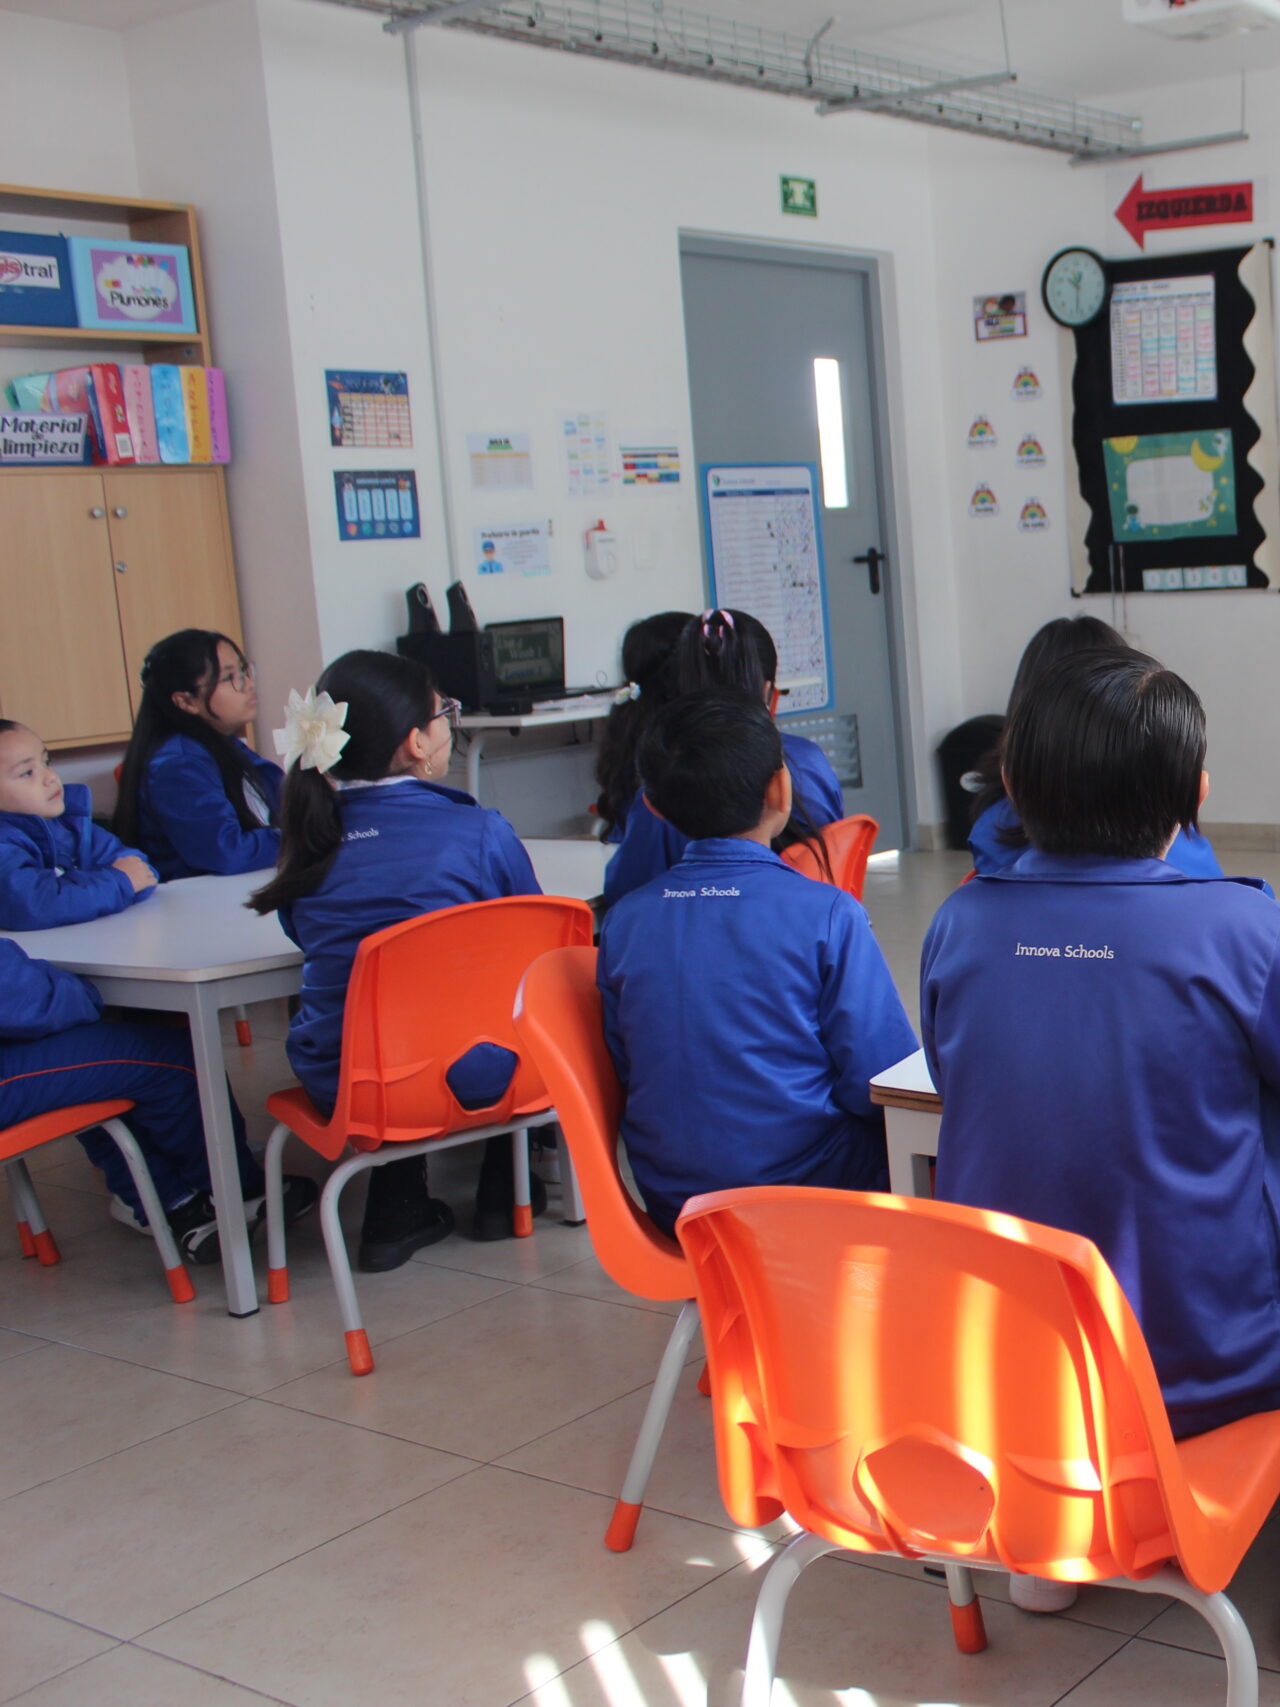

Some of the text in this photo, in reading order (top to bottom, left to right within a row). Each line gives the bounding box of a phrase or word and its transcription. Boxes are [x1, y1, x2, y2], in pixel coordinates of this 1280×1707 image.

[1136, 192, 1248, 222] IZQUIERDA
[109, 290, 169, 309] Plumones
[1, 416, 83, 433] Material
[3, 438, 79, 457] limpieza
[347, 828, 379, 841] Schools
[662, 886, 741, 898] Innova Schools
[1015, 942, 1115, 960] Innova Schools
